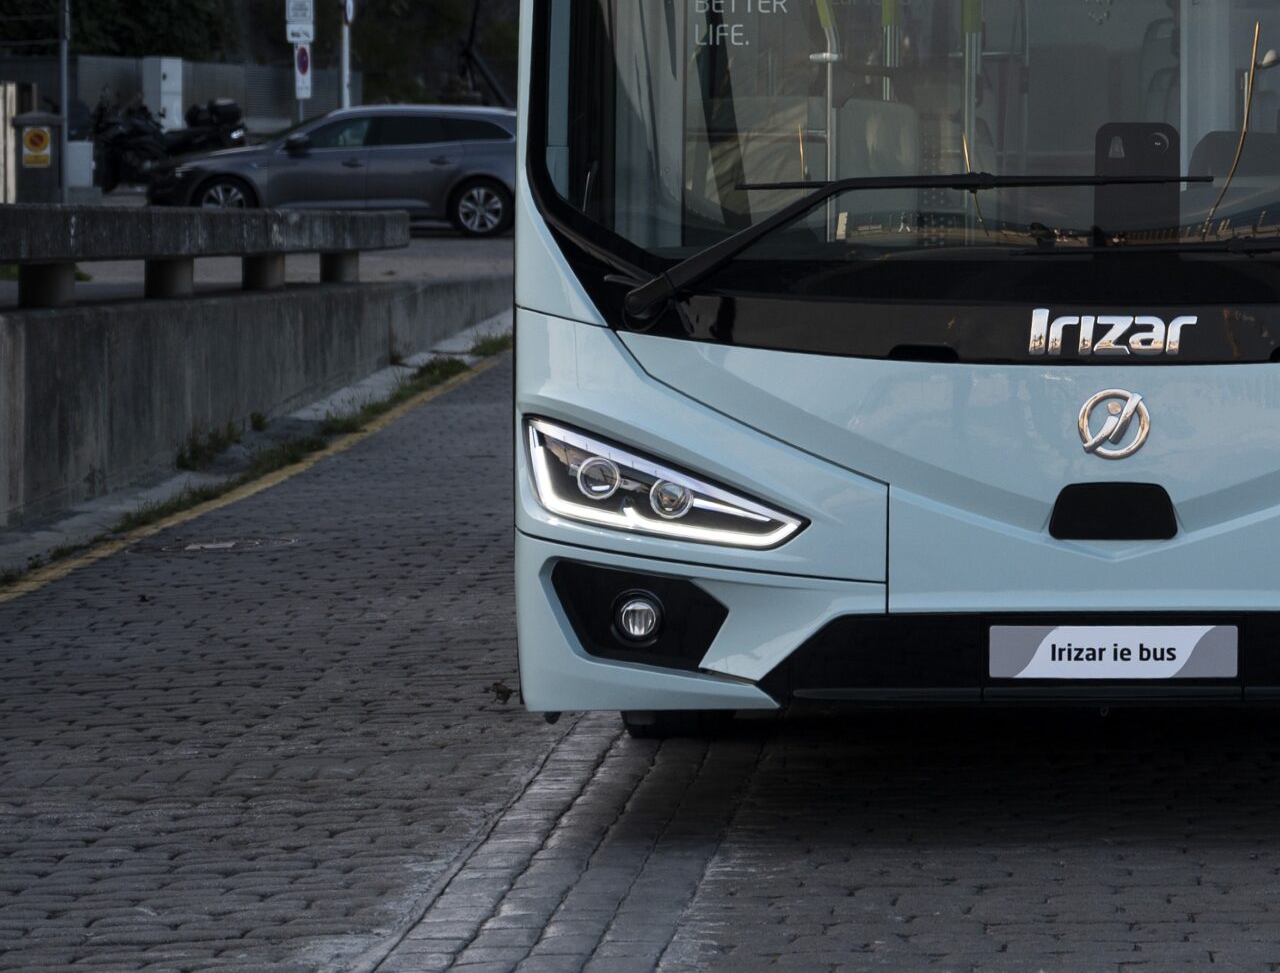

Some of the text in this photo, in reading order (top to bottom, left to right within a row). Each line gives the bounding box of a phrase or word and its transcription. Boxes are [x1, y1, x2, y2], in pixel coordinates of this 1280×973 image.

[695, 23, 750, 46] LIFE.
[1028, 308, 1198, 356] Irizar
[1051, 642, 1177, 662] Irizar ie bus
